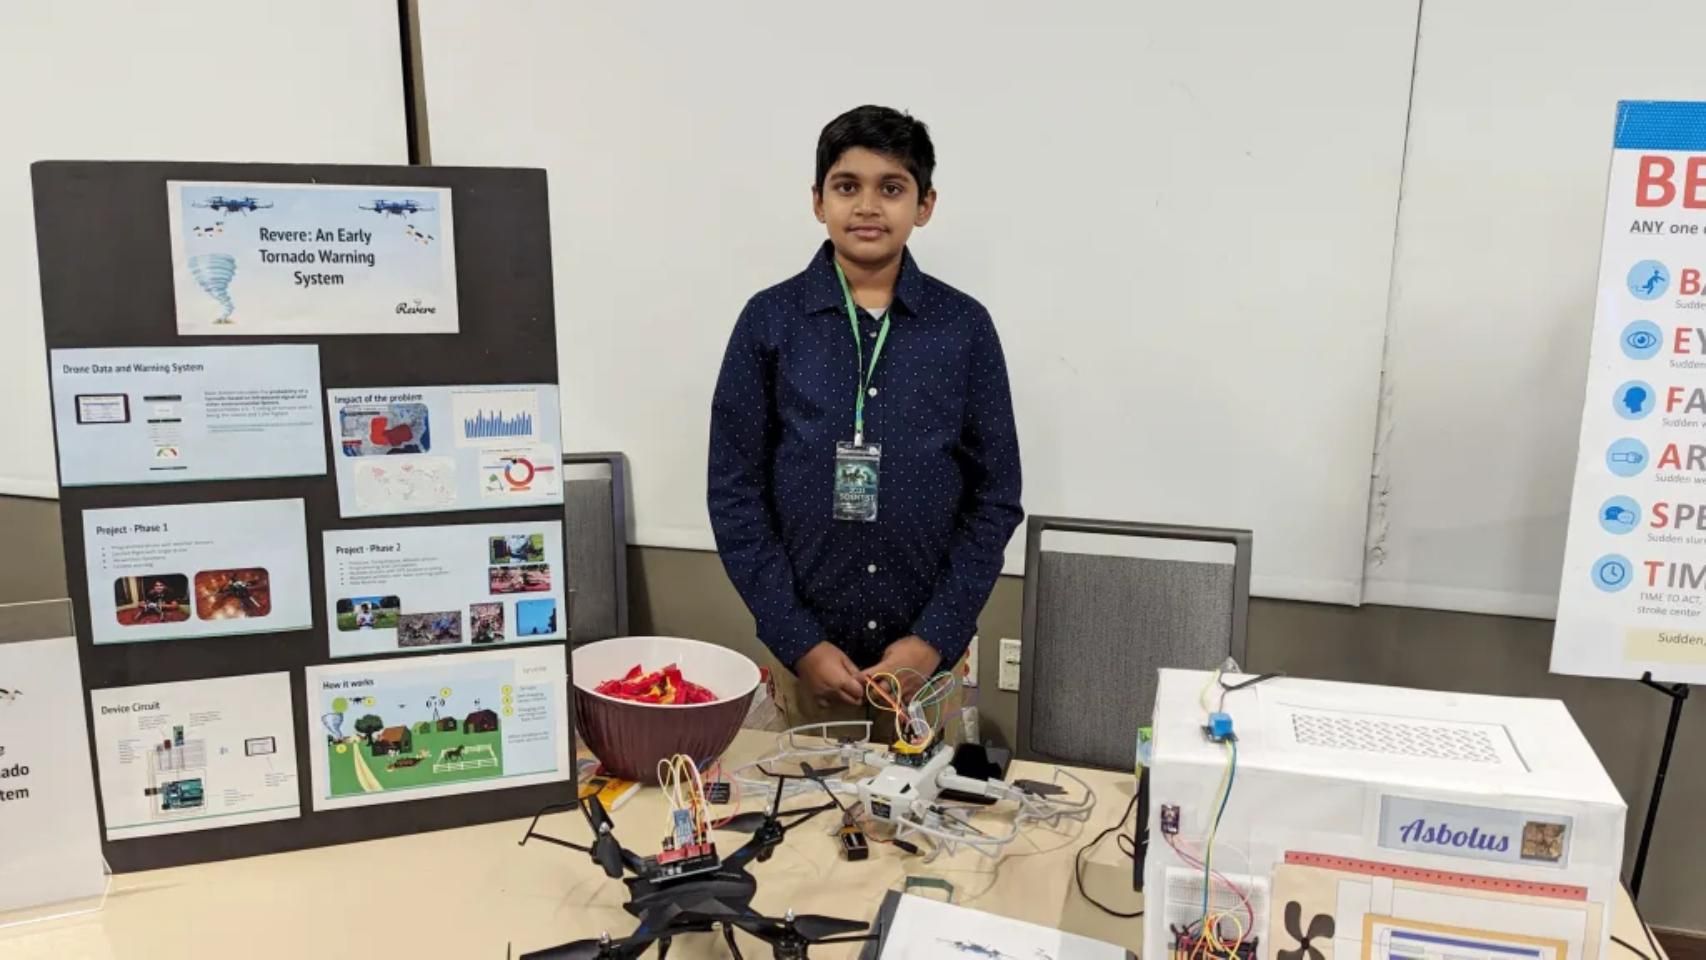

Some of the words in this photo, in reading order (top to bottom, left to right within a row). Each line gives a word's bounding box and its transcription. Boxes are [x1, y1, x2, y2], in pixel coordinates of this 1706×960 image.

[1635, 155, 1706, 209] BE
[1630, 220, 1664, 234] ANY
[1670, 224, 1698, 234] one
[259, 227, 312, 243] Revere:
[316, 228, 334, 242] An
[338, 228, 372, 245] Early
[259, 249, 315, 264] Tornado
[319, 250, 375, 267] Warning
[294, 271, 344, 288] System
[396, 302, 436, 315] Revere
[63, 364, 90, 375] Drone
[92, 364, 113, 374] Data
[115, 363, 132, 373] and
[134, 363, 170, 374] Warning
[172, 362, 203, 374] System
[335, 395, 362, 405] Impact
[364, 394, 373, 402] of
[374, 394, 387, 402] the
[389, 393, 423, 403] problem
[1662, 418, 1698, 427] Sudden
[1657, 443, 1706, 470] AR
[1656, 473, 1691, 483] Sudden
[96, 525, 128, 536] Project
[134, 523, 160, 533] Phase
[163, 523, 168, 532] 1
[1648, 533, 1683, 543] Sudden
[336, 545, 364, 555] Project
[369, 544, 394, 552] Phase
[396, 543, 401, 551] 2
[1640, 592, 1664, 602] TIME
[1667, 593, 1680, 602] TO
[1637, 606, 1667, 616] stroke
[1669, 608, 1701, 617] center
[323, 680, 341, 689] How
[343, 680, 349, 688] it
[351, 678, 374, 687] works
[101, 704, 130, 715] Device
[132, 701, 160, 712] Circuit
[1400, 819, 1509, 852] Asbolus
